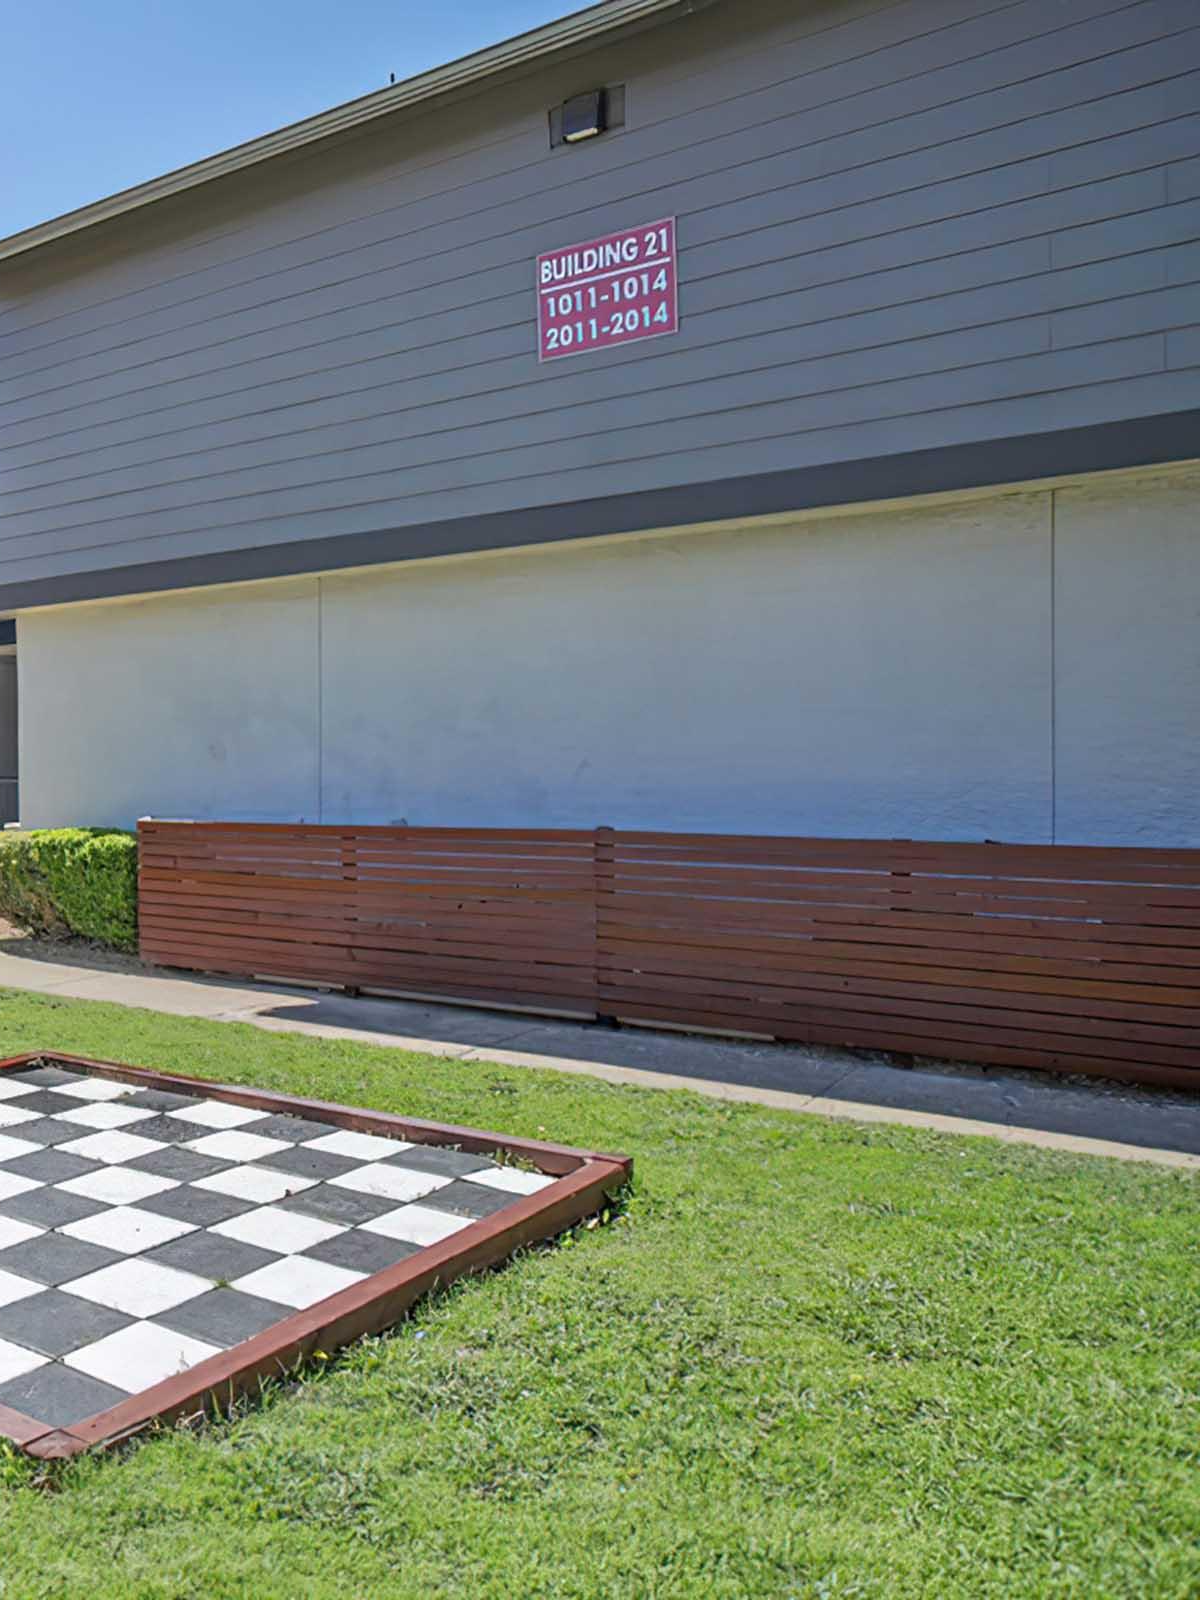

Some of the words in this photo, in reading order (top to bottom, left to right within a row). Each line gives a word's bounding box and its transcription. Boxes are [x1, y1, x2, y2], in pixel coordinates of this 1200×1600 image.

[540, 237, 638, 284] BUILDING
[644, 228, 668, 257] 21
[547, 268, 667, 318] 1011-1014
[546, 301, 669, 350] 2011-2014
